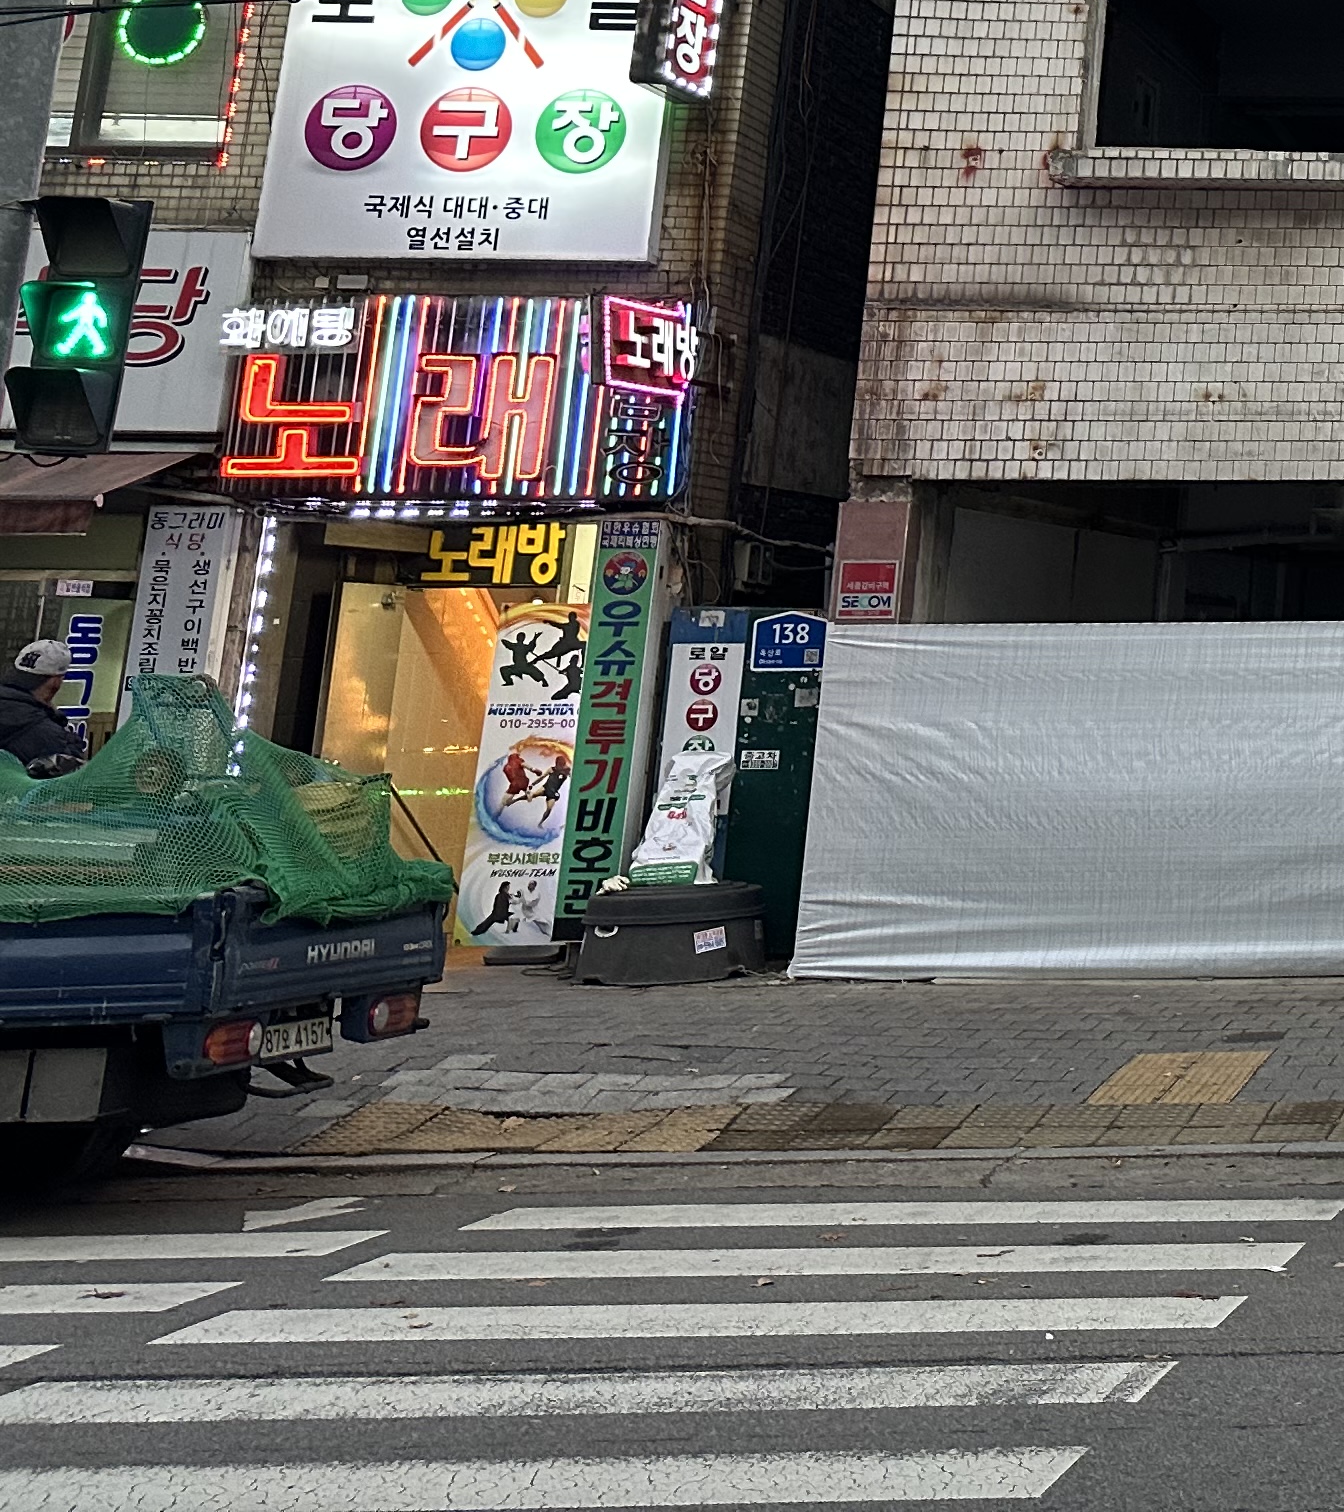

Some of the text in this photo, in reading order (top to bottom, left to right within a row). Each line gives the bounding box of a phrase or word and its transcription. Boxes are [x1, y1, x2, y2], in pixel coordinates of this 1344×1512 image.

[320, 98, 619, 165] 당구장
[363, 194, 434, 219] 국제식
[406, 226, 500, 253] 열선설치
[627, 310, 699, 381] 노래방
[220, 353, 557, 481] 노래
[151, 511, 226, 531] 동그라미
[165, 533, 206, 551] 식당
[420, 522, 567, 585] 노래방
[841, 595, 892, 609] SECOM
[177, 559, 212, 675] 생선구이백반
[772, 623, 811, 644] 138
[688, 646, 729, 661] 로얄
[489, 868, 557, 879] WUSHU-TEAM
[306, 938, 376, 964] HYUNDAI
[294, 1020, 326, 1051] 4157
